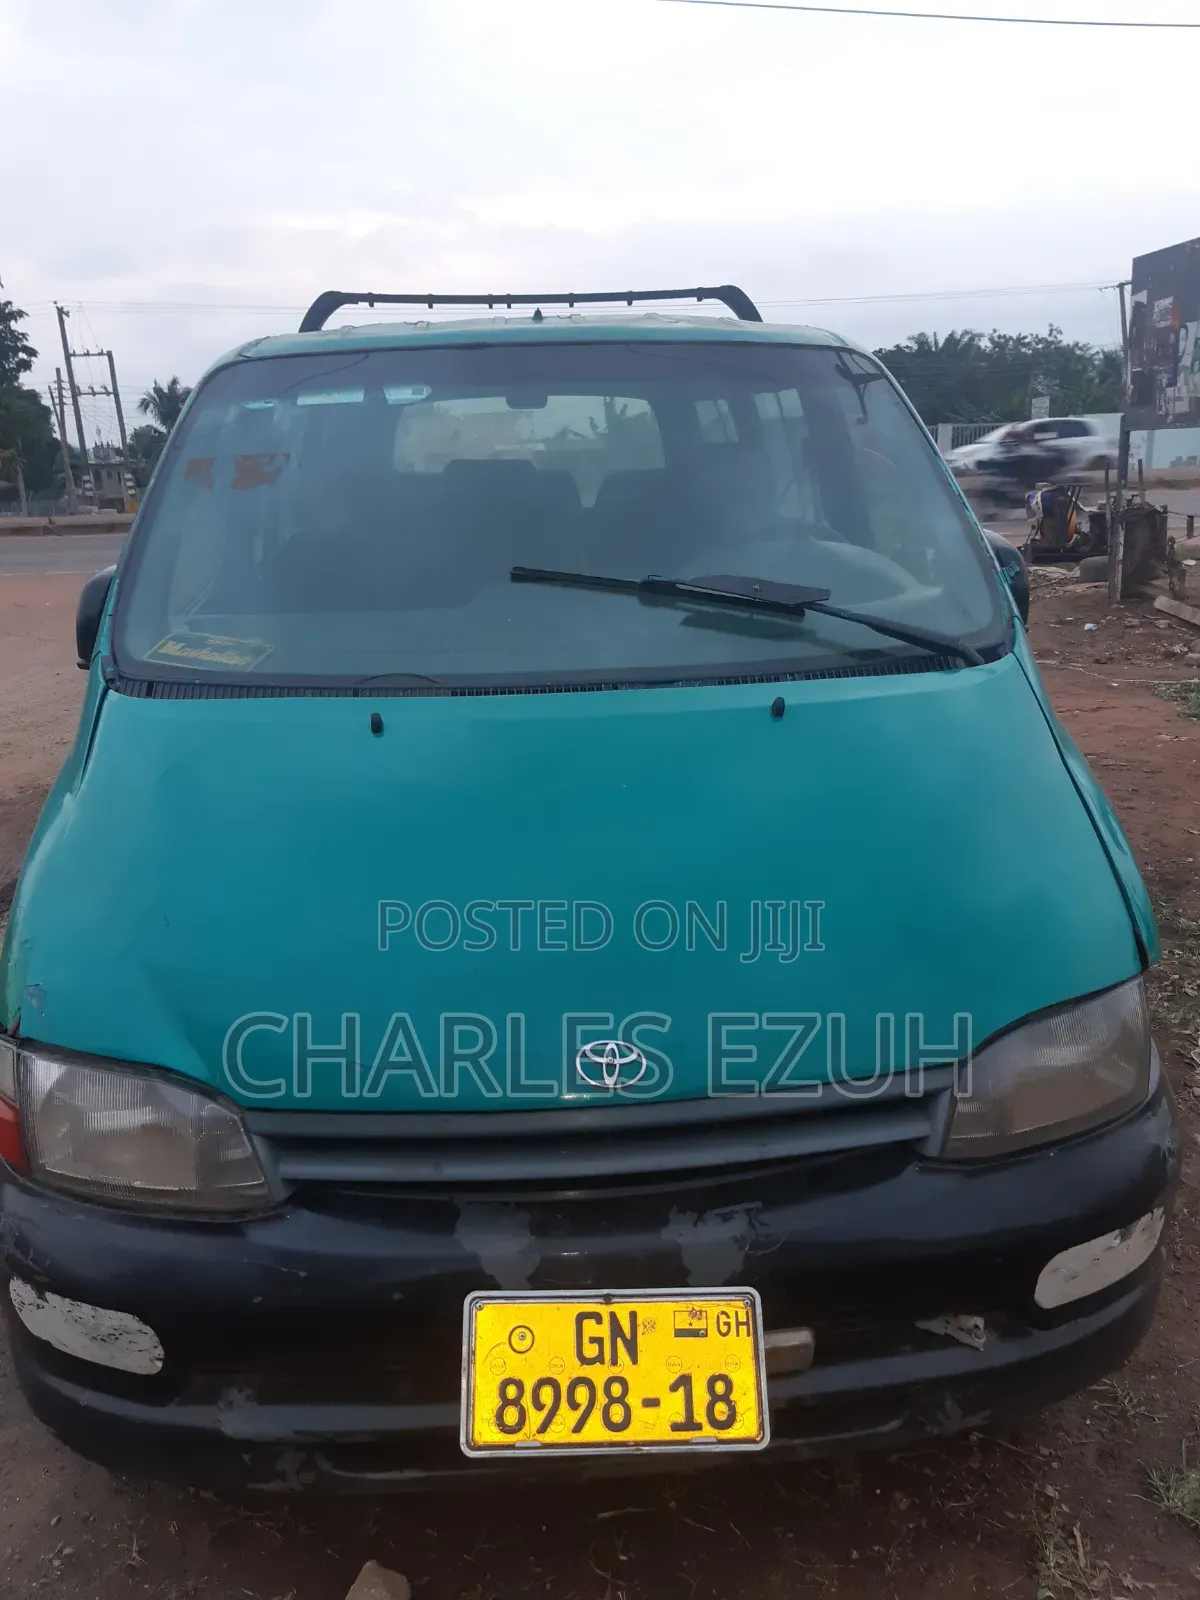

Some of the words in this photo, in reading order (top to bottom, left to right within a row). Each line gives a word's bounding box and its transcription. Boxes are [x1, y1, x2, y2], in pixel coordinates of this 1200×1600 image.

[575, 1310, 639, 1366] GN
[716, 1310, 751, 1338] GH
[495, 1373, 737, 1435] 8998-18
